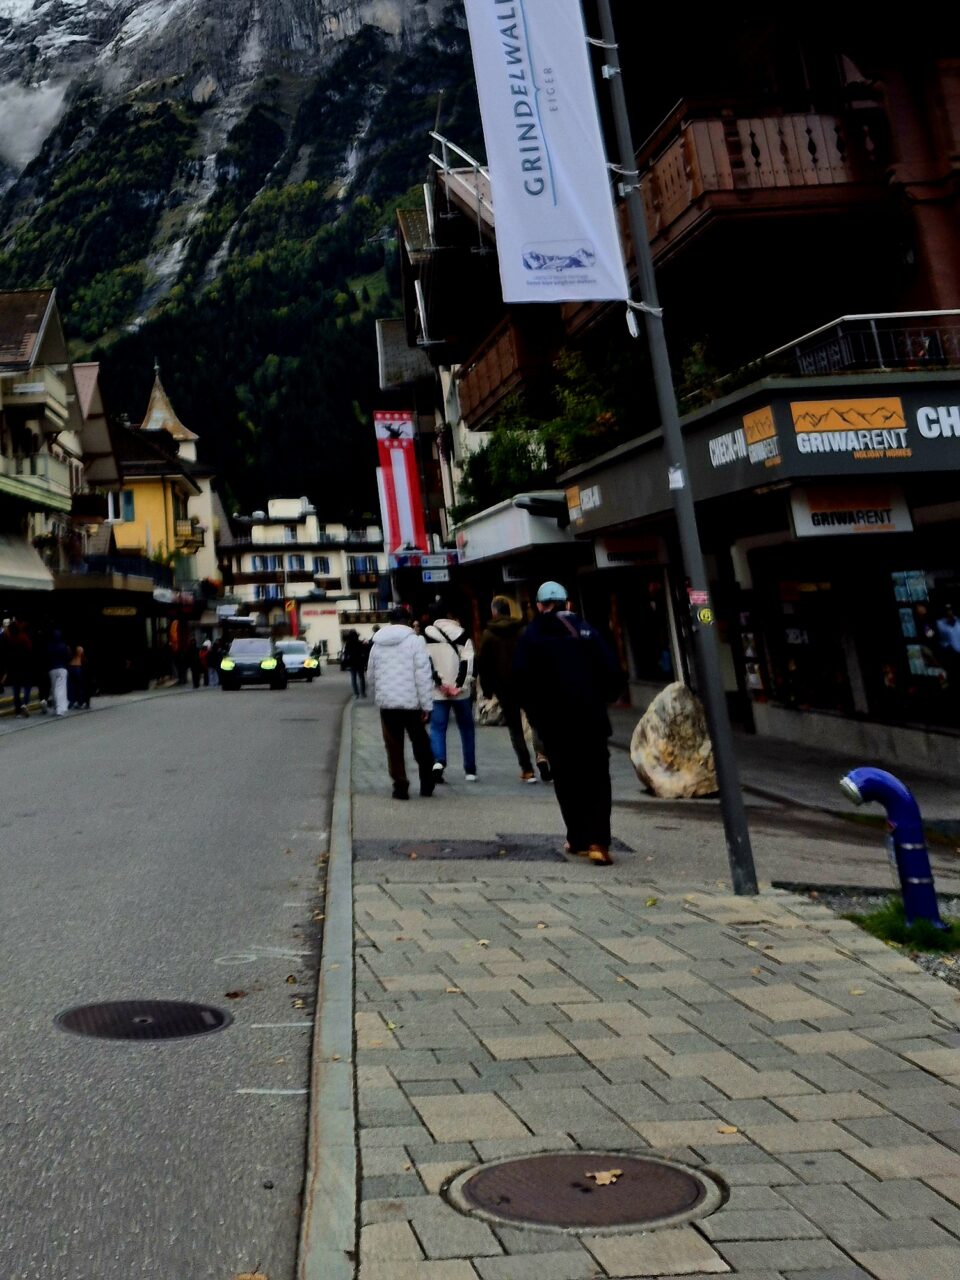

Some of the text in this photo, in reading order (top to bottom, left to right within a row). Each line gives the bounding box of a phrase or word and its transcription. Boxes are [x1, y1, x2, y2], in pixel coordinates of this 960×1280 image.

[543, 67, 558, 112] EIGER
[796, 428, 908, 455] GRIWARENT
[811, 508, 893, 527] GRIWARENT
